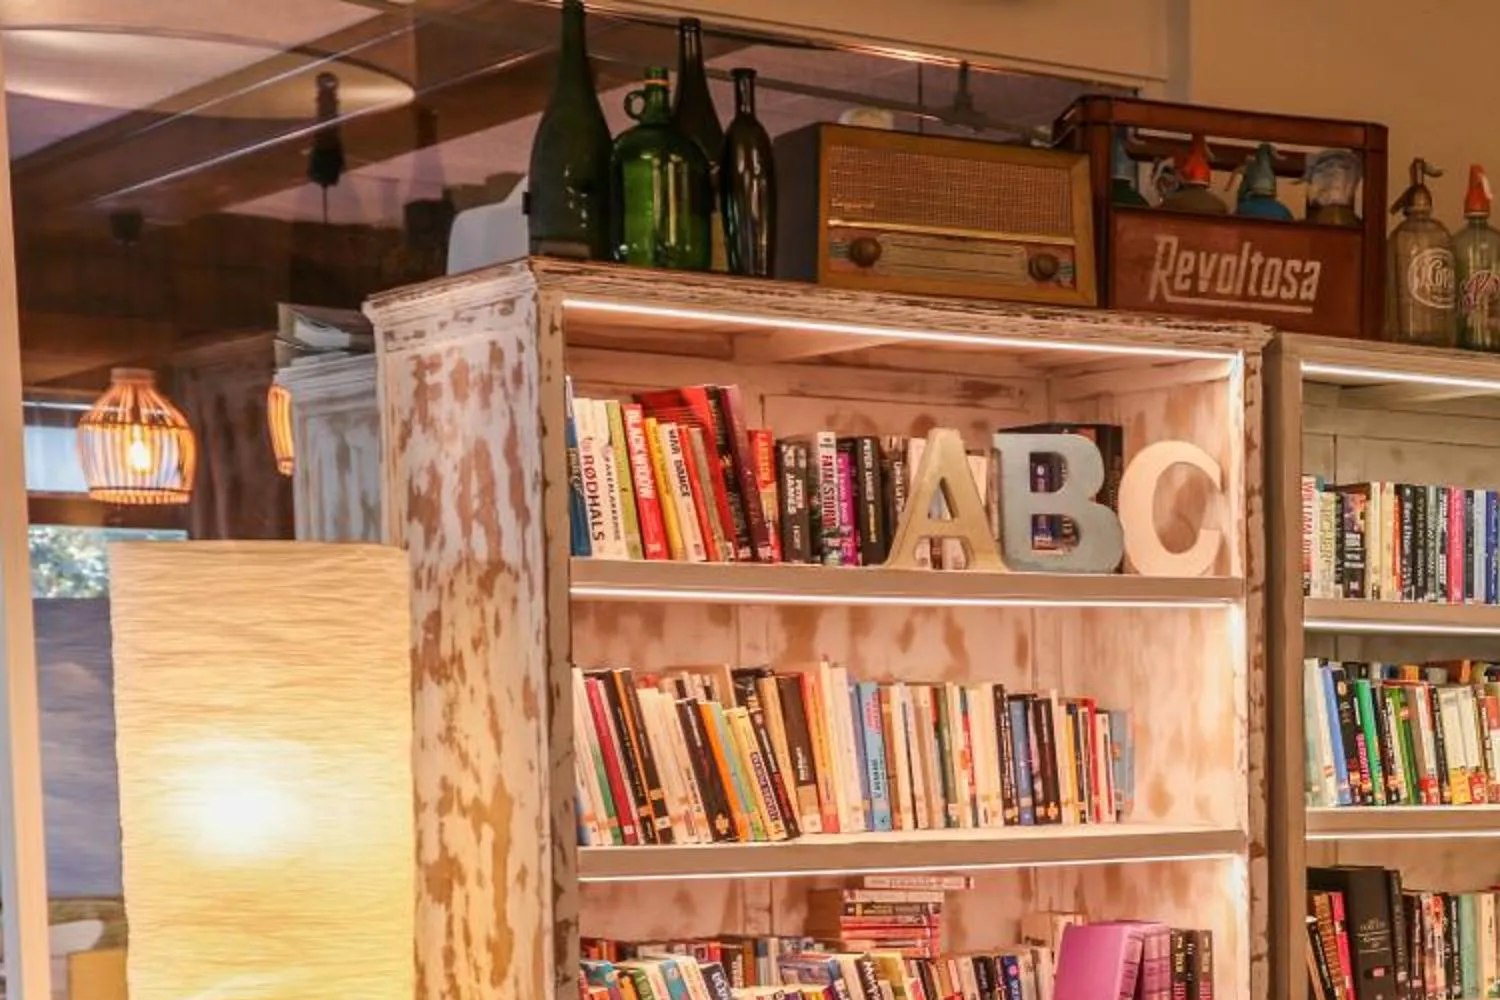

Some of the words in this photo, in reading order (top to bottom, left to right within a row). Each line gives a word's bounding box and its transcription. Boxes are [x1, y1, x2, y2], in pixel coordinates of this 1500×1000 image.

[1149, 234, 1321, 302] Revoltosa
[863, 439, 873, 469] PETER
[583, 454, 605, 541] RØDHALS
